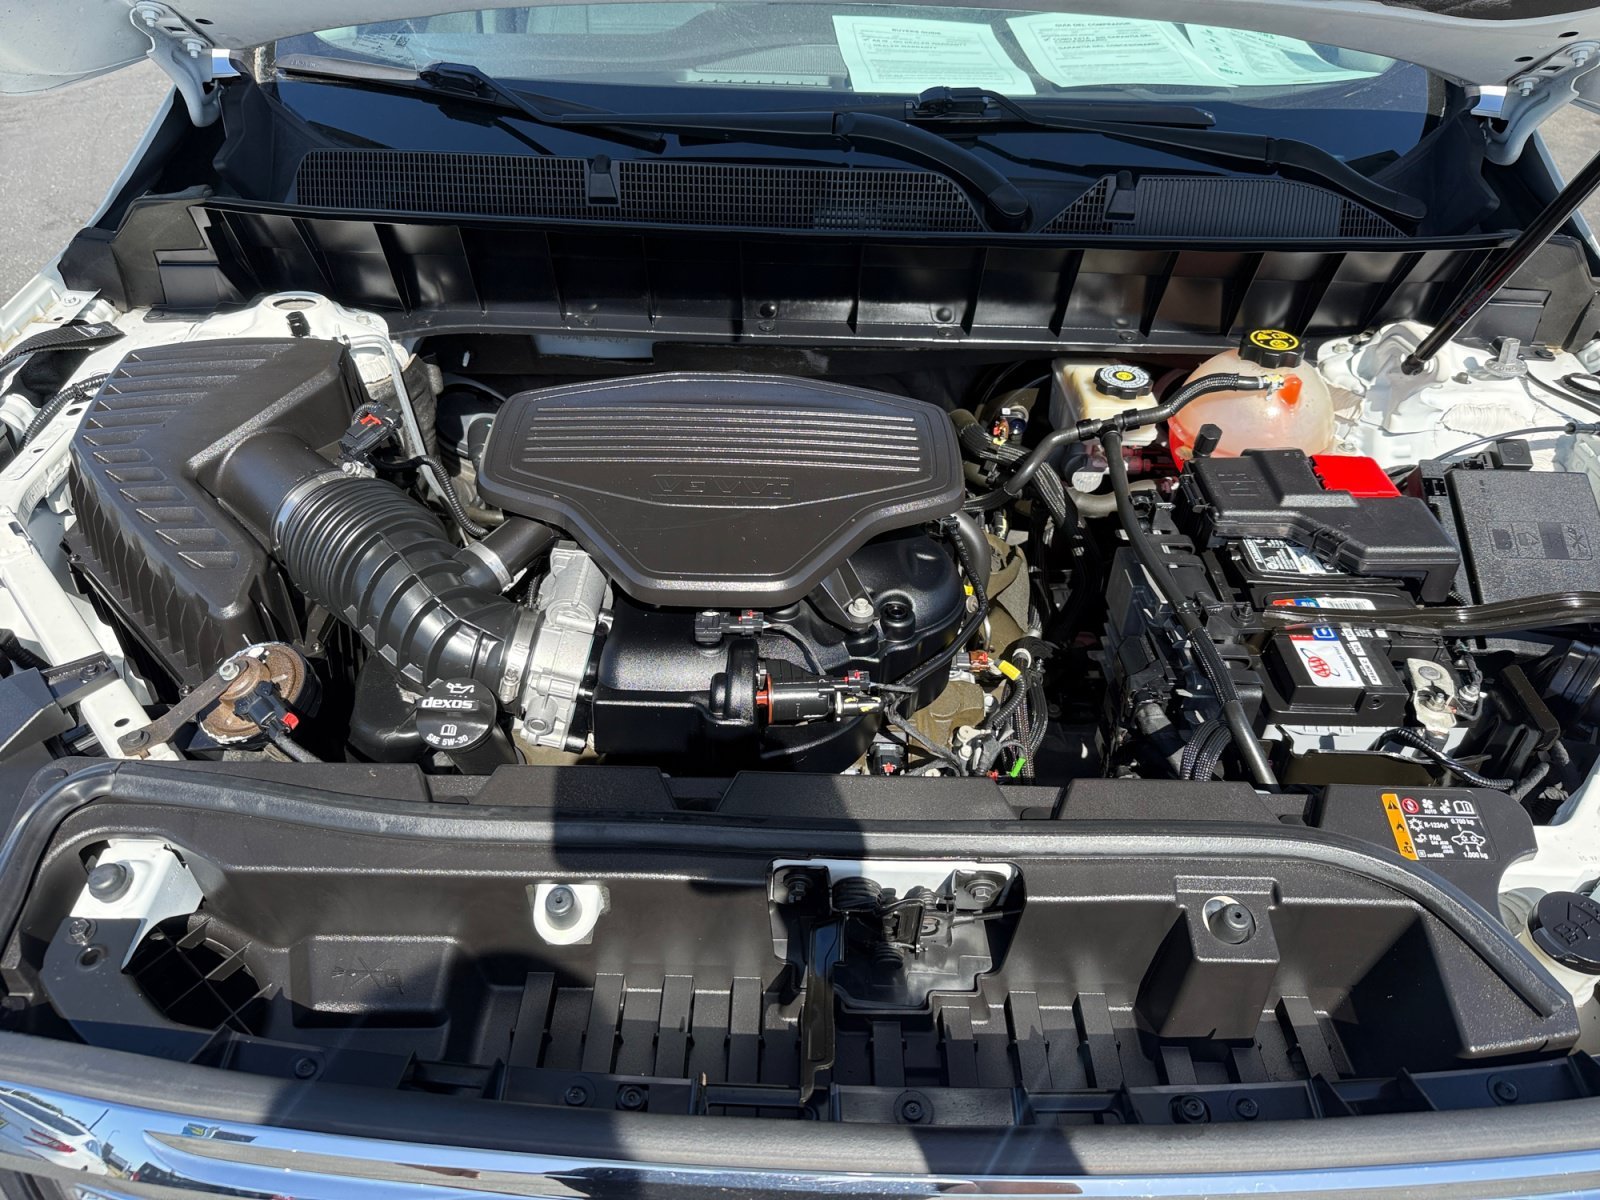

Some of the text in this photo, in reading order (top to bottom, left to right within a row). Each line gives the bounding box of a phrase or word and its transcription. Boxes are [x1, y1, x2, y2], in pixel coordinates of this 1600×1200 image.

[421, 696, 476, 709] dexos
[426, 733, 469, 746] SAE 5W-30
